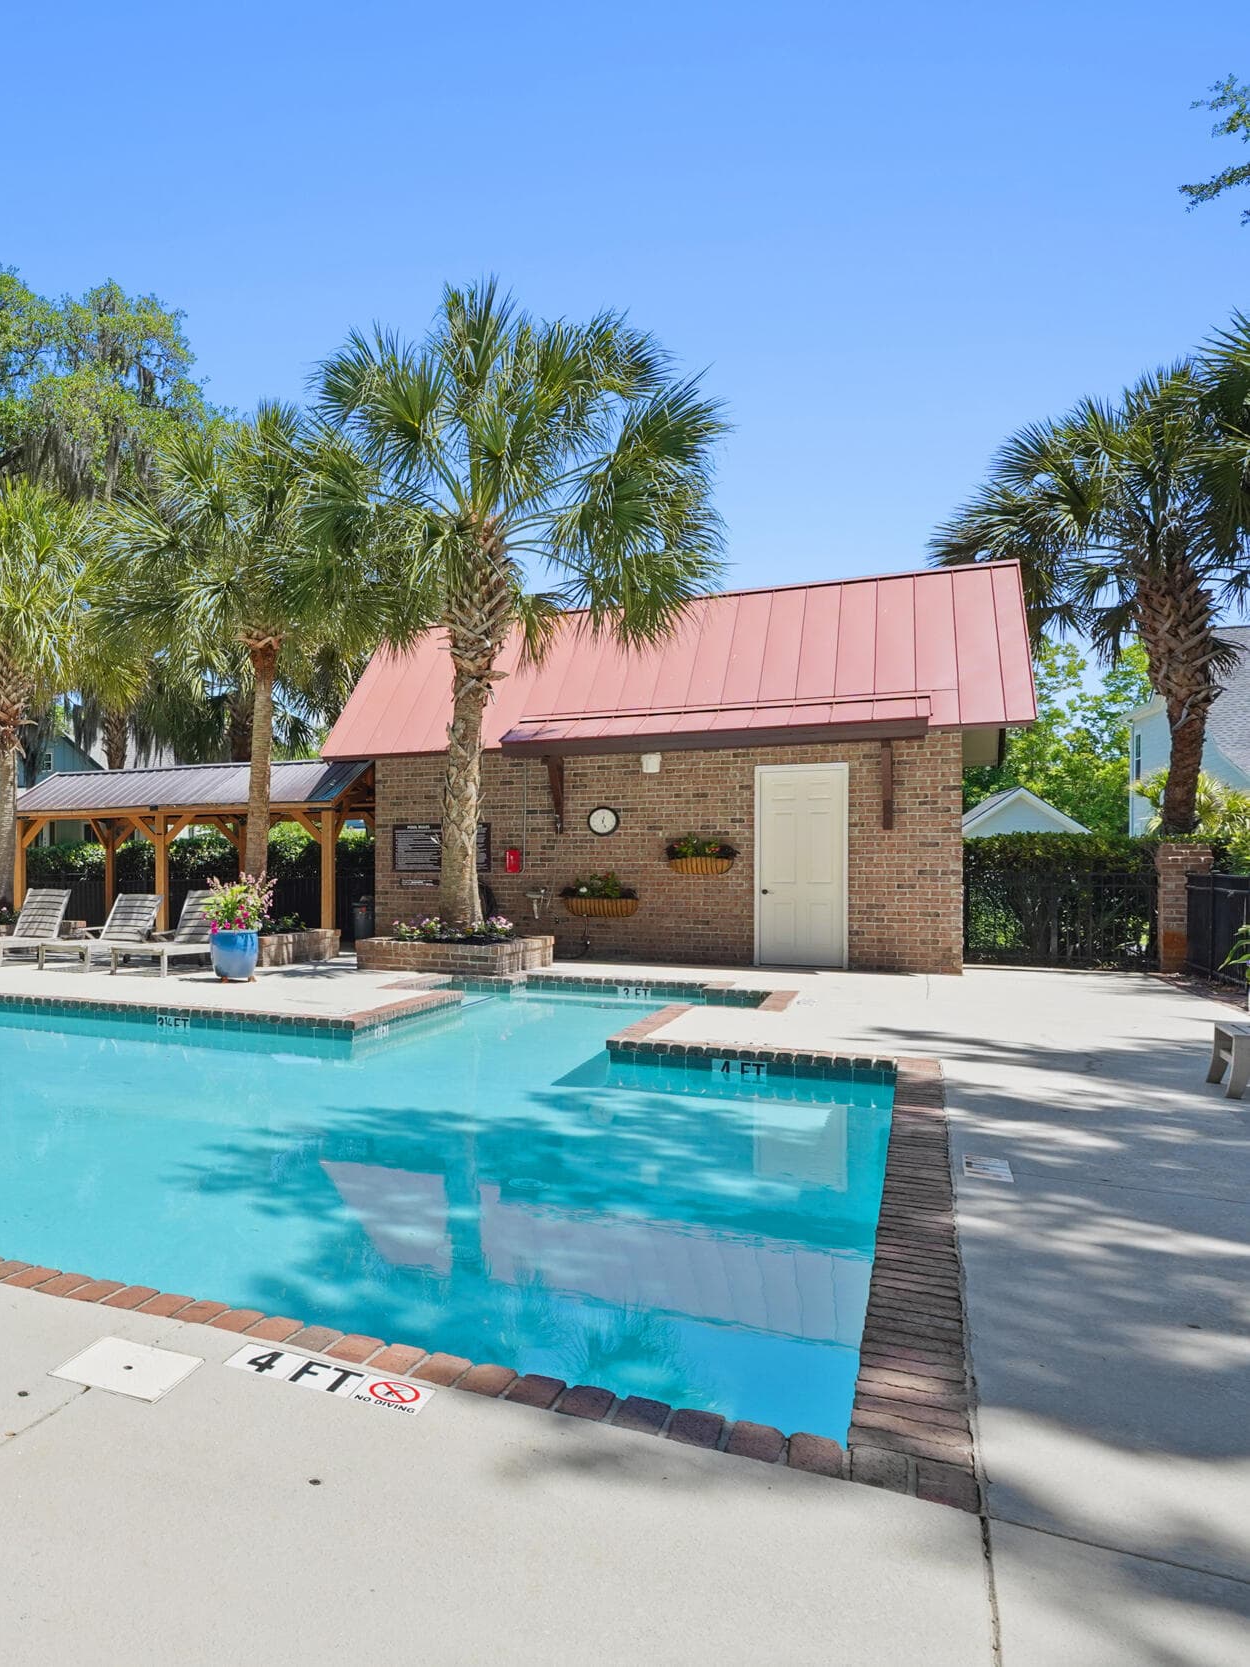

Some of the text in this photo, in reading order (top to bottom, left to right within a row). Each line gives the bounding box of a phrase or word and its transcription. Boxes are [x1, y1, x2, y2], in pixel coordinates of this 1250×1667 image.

[635, 987, 650, 997] FT
[740, 1062, 766, 1076] FT
[247, 1351, 365, 1393] 4 FT
[354, 1393, 416, 1415] NO DIVING
